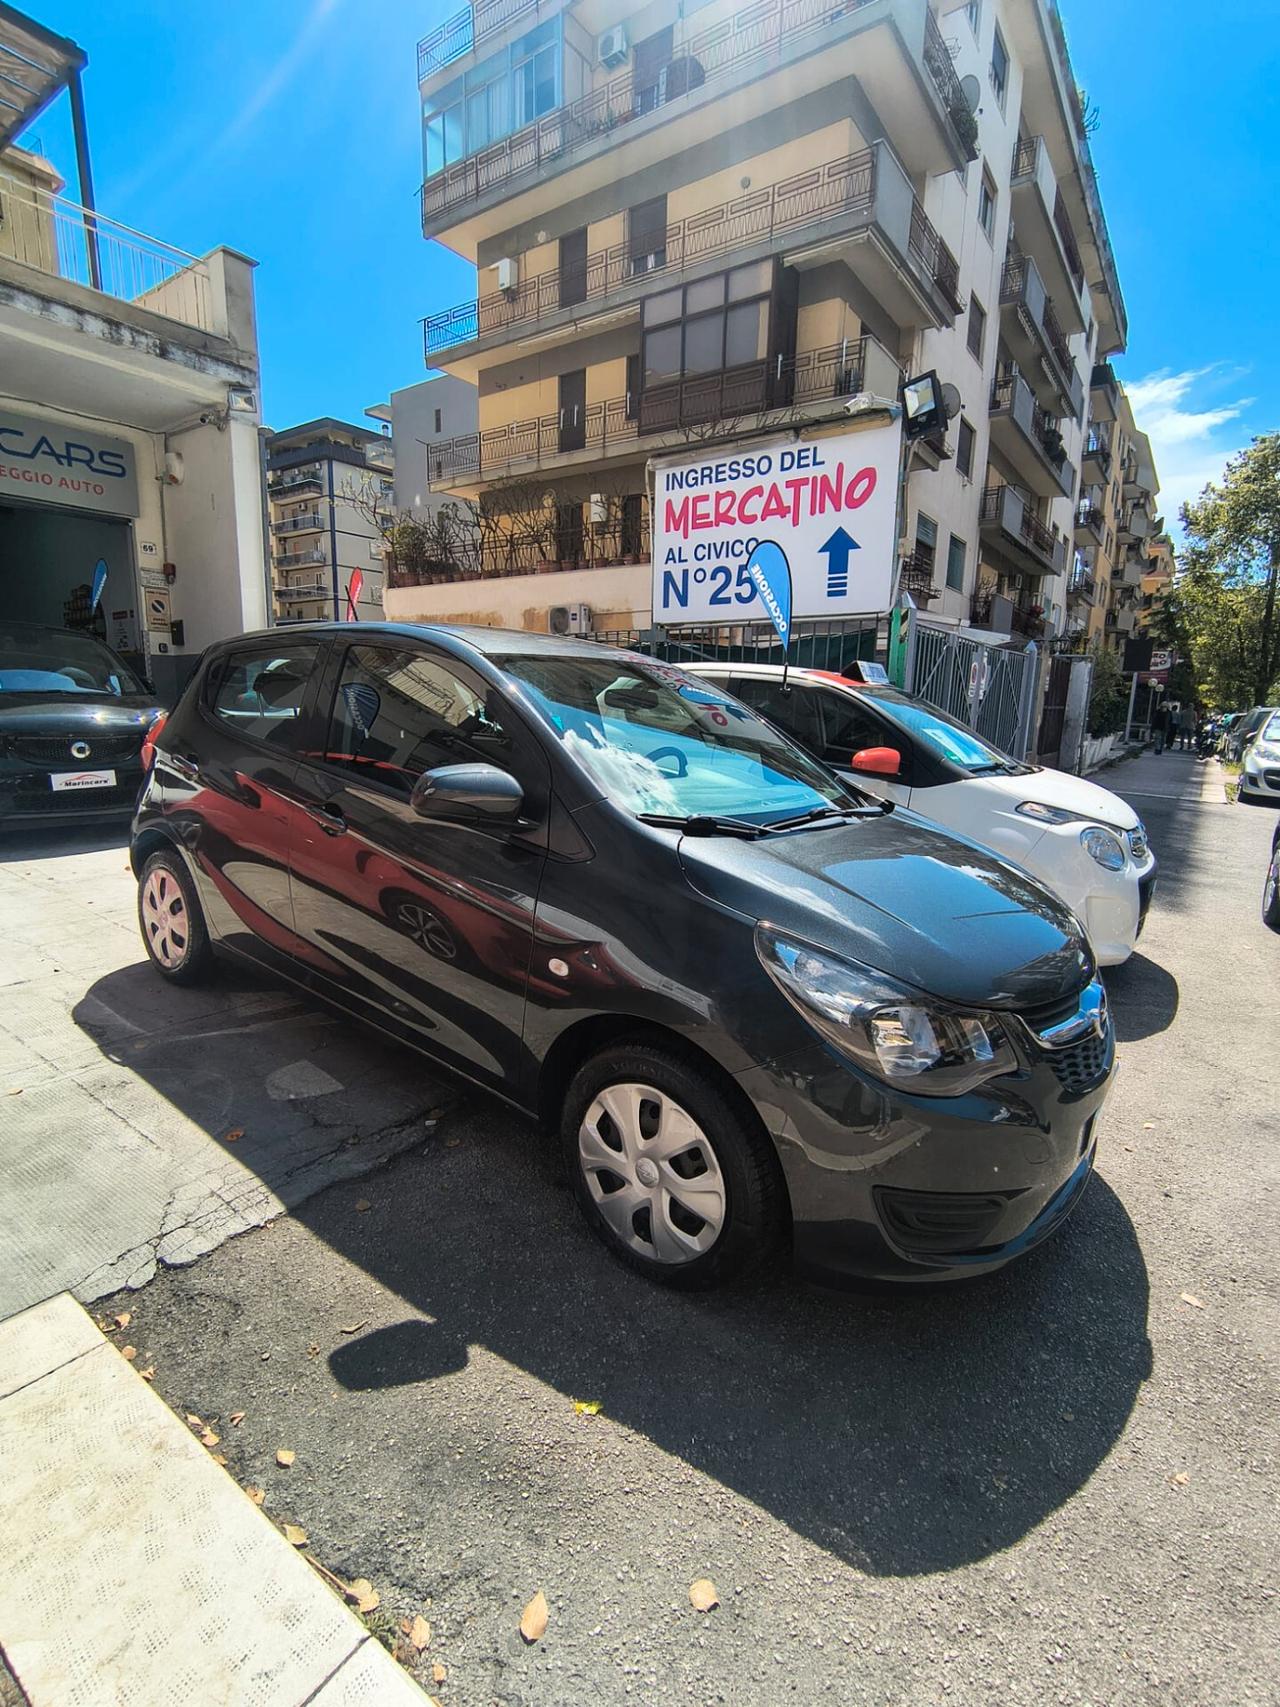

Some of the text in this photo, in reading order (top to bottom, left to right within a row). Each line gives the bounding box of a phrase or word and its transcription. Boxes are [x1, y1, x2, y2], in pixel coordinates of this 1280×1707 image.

[58, 477, 105, 496] AUTO
[665, 446, 826, 492] INGRESSO DEL
[665, 462, 878, 540] MERCATINO
[664, 537, 760, 565] AL CIVICO
